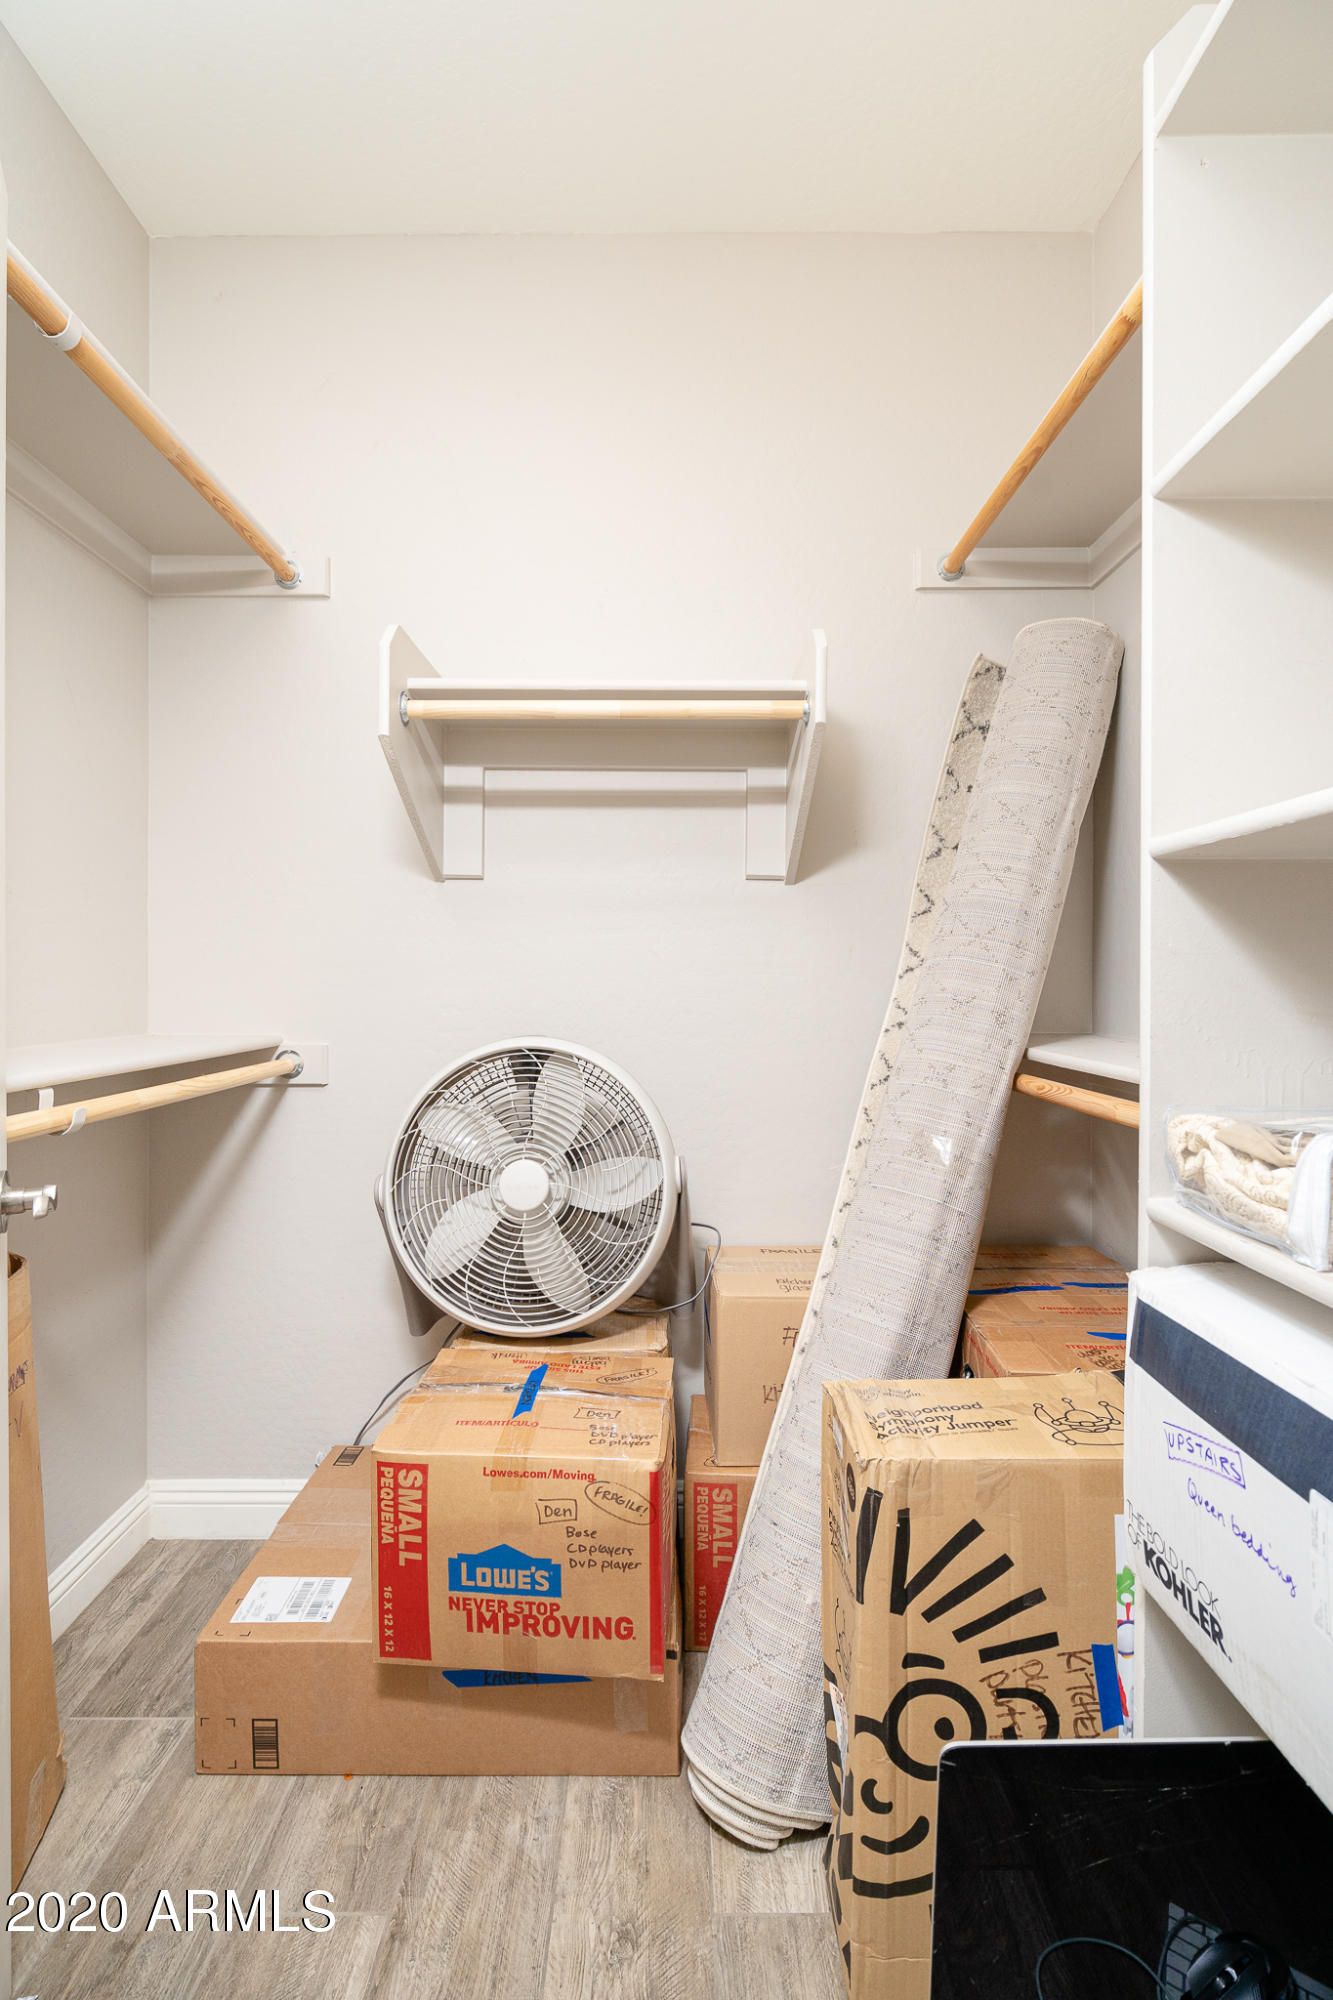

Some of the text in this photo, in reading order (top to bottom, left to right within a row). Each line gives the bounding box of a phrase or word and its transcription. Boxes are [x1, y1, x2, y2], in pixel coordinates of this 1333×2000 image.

[586, 1409, 614, 1418] Den
[864, 1401, 984, 1425] Neighborhood
[870, 1412, 956, 1433] Symphony
[876, 1424, 940, 1441] Activity
[1168, 1434, 1242, 1482] UPSTAIRS
[482, 1466, 596, 1482] Lowes.com/Moving
[380, 1466, 395, 1545] PEQUEÑA
[543, 1504, 573, 1518] Den
[593, 1485, 650, 1517] FRAGILE!
[397, 1468, 424, 1567] SMALL
[696, 1486, 709, 1551] PEQUEÑA
[711, 1487, 733, 1568] SMALL
[566, 1525, 598, 1540] Bose
[1127, 1523, 1141, 1550] OF
[1187, 1477, 1226, 1527] Queen
[1231, 1514, 1297, 1598] bedding
[569, 1559, 642, 1573] DVD player
[1127, 1498, 1222, 1620] THE BOLD LOOK
[461, 1562, 550, 1592] LOWE'S
[698, 1584, 707, 1597] 16
[383, 1585, 394, 1652] 16 X 12 X 12
[448, 1596, 561, 1618] NEVER STOP
[698, 1609, 707, 1619] 12
